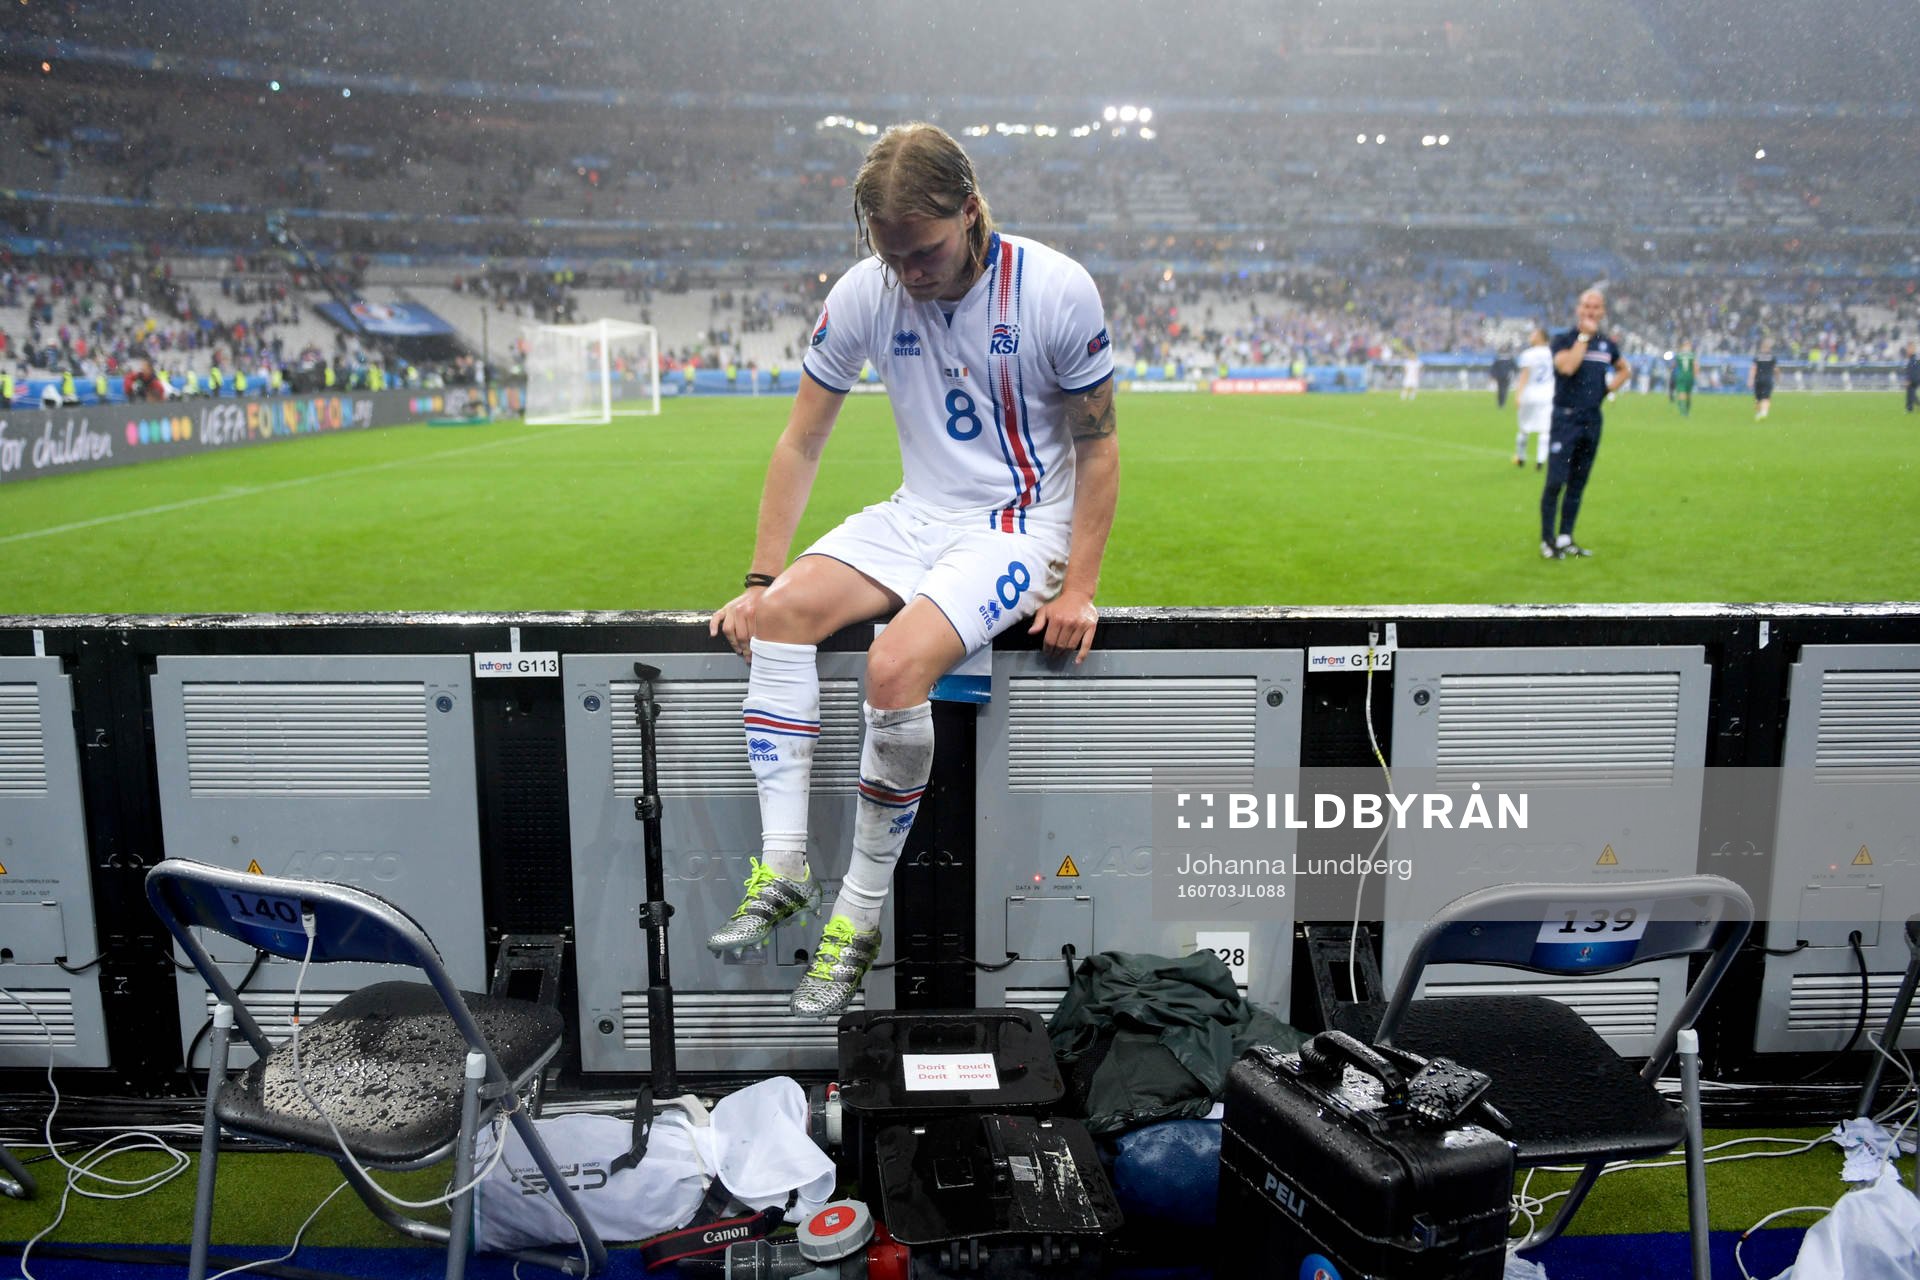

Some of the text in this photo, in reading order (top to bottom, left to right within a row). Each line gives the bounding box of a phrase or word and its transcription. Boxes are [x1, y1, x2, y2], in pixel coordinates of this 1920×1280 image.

[945, 388, 982, 441] 8
[33, 417, 113, 468] children
[996, 561, 1030, 610] 8
[518, 660, 557, 672] G113
[1351, 653, 1389, 667] G112
[232, 893, 298, 924] 140
[1558, 907, 1637, 934] 139
[1208, 948, 1244, 966] 28
[1264, 1172, 1306, 1218] PELI
[703, 1226, 749, 1244] Canon
